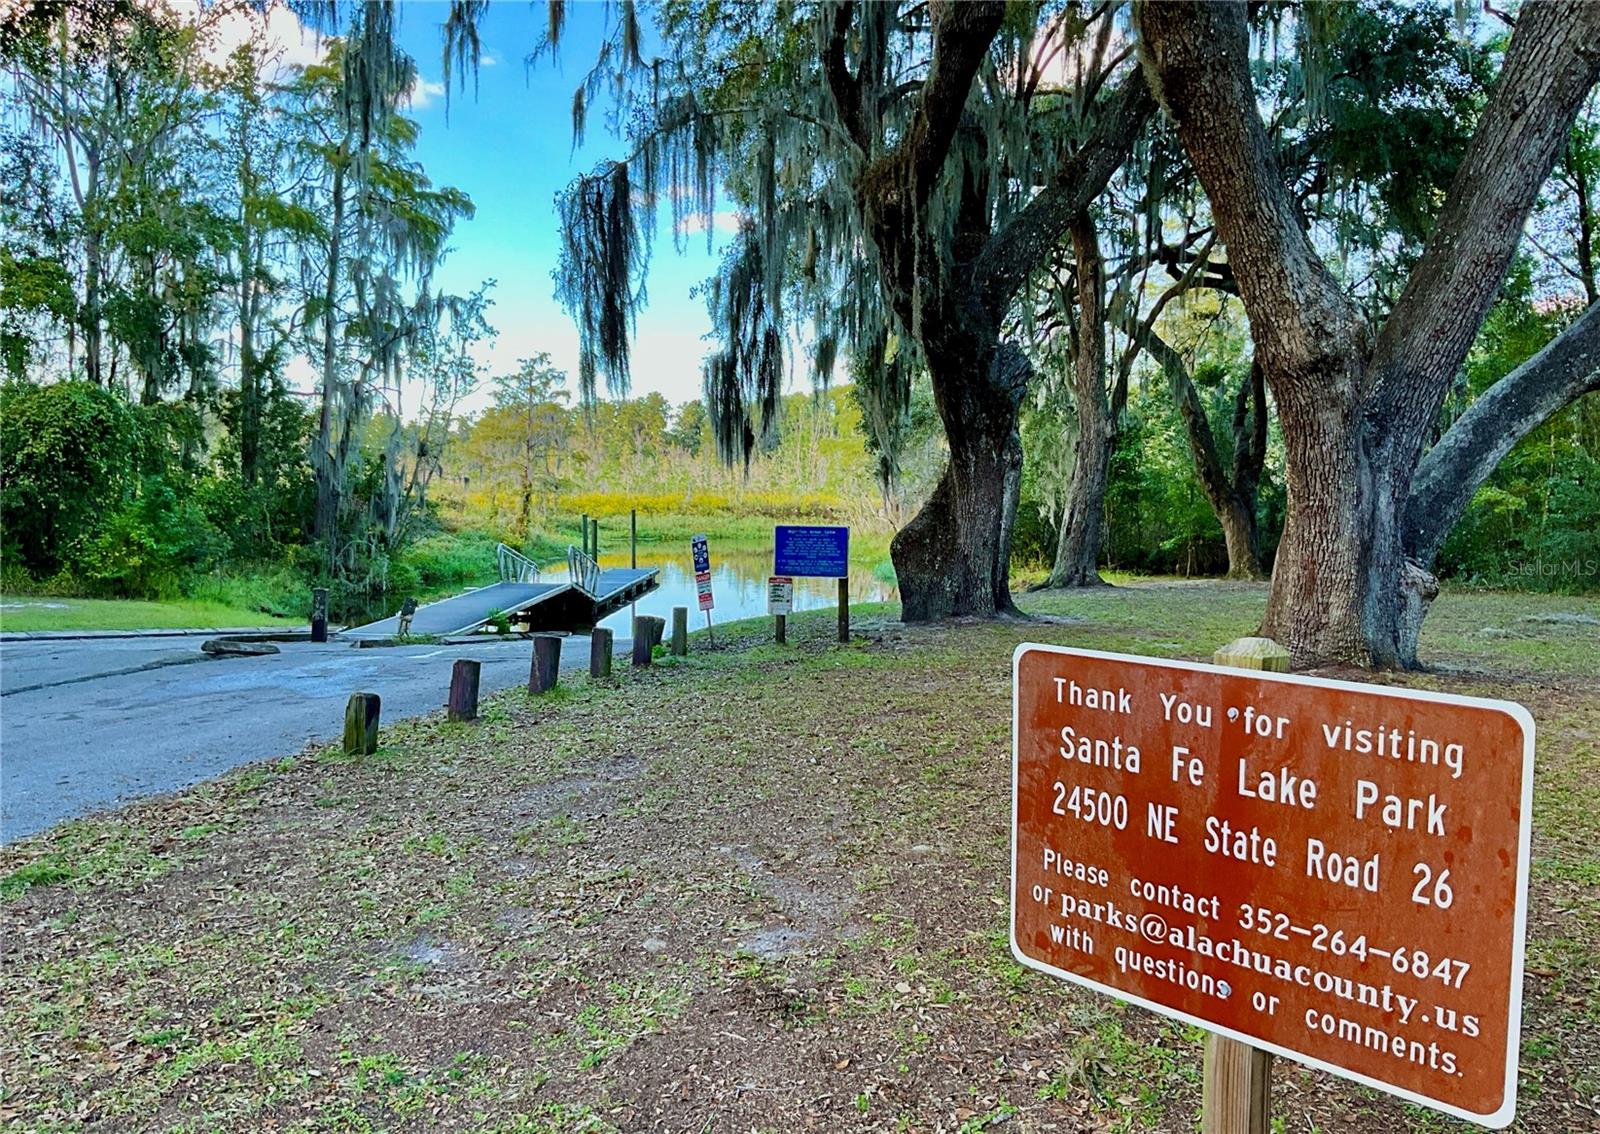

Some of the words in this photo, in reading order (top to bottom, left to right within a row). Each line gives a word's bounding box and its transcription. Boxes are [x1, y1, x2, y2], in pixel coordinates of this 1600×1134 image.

[1053, 677, 1132, 714] Thank
[1159, 692, 1212, 728] You
[1243, 705, 1291, 739] for
[1322, 718, 1464, 781] visiting
[1059, 726, 1140, 774] Santa
[1172, 745, 1204, 786] Fe
[1238, 758, 1317, 809] Lake
[1356, 779, 1447, 837] Park
[1052, 781, 1128, 830] 24500
[1147, 802, 1179, 844] NE
[1204, 816, 1277, 867] State
[1306, 838, 1379, 893] Road
[1411, 862, 1453, 909] 26
[1032, 884, 1053, 902] or
[1060, 893, 1480, 1037] parks@alachuacounty.us
[1043, 847, 1109, 888] Please
[1130, 878, 1220, 920] contact
[1238, 903, 1471, 989] 352-264-6847
[1050, 923, 1094, 955] with
[1114, 942, 1231, 1000] questions
[1252, 991, 1281, 1016] or
[1305, 1008, 1463, 1078] comments.
